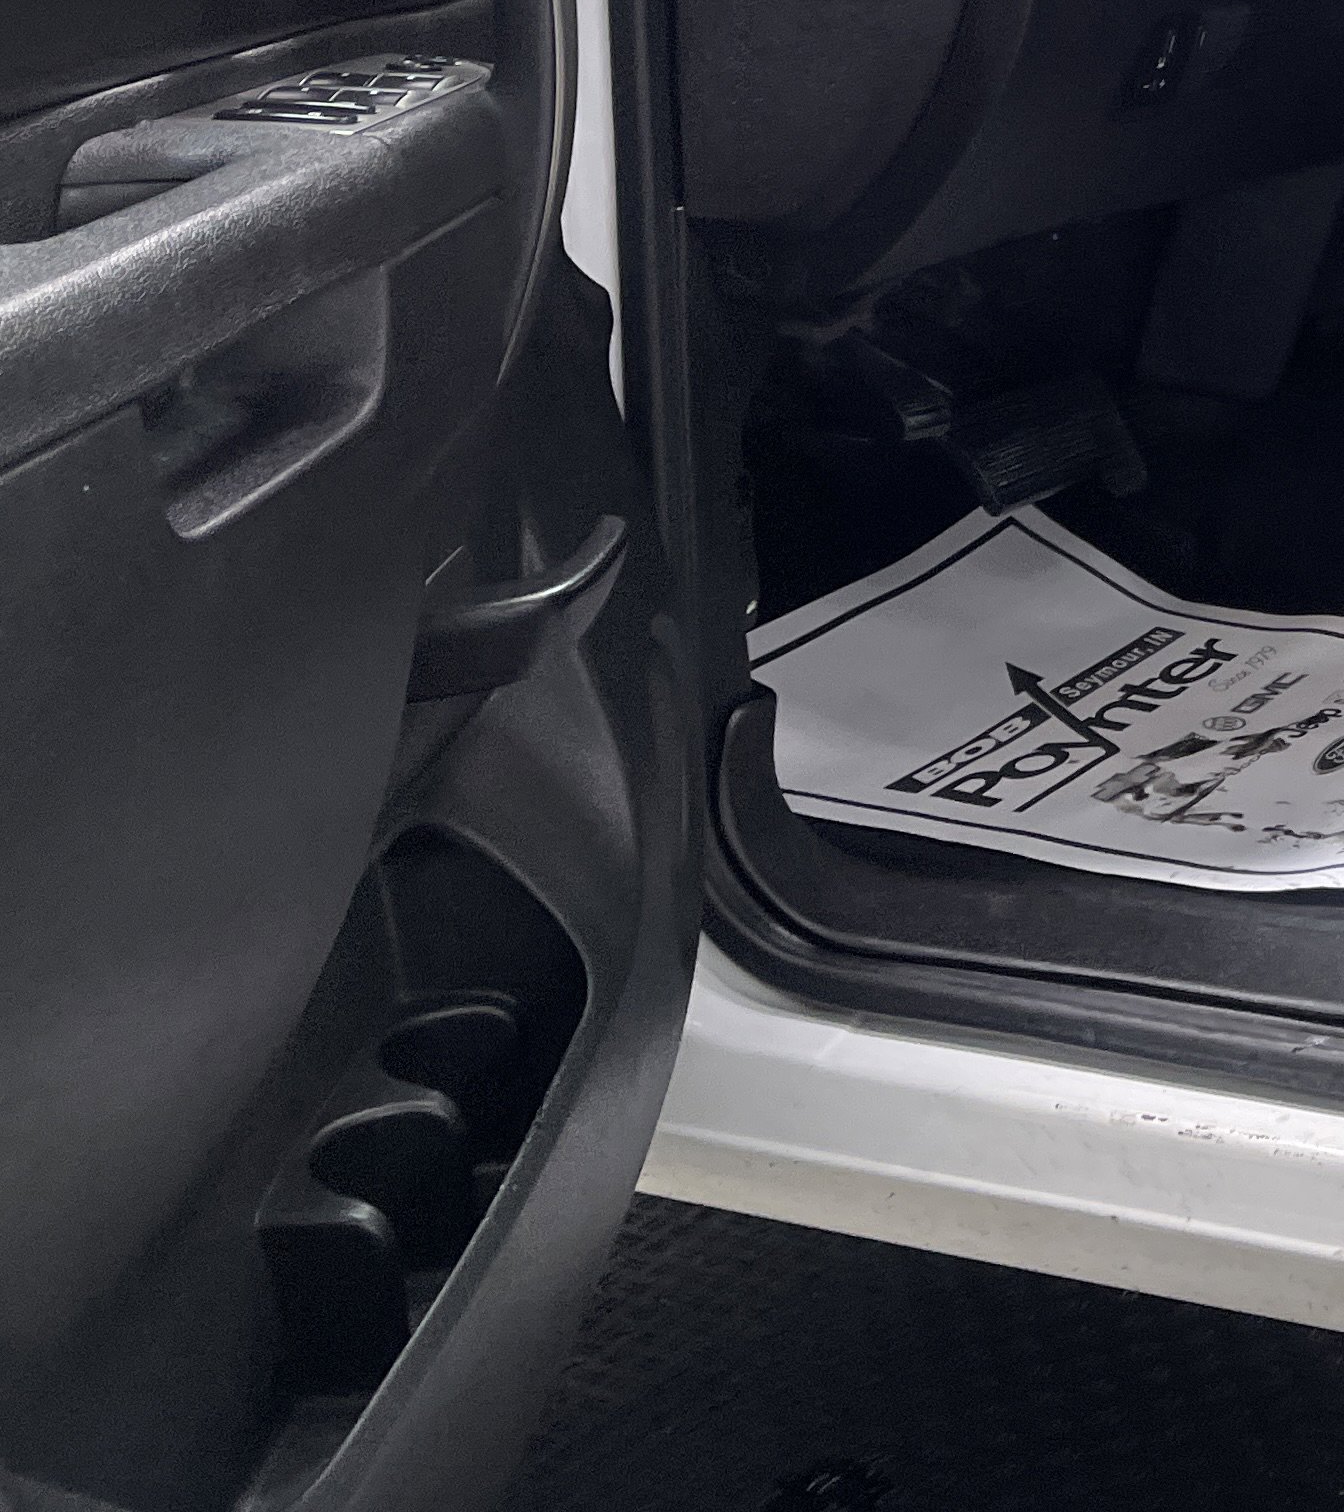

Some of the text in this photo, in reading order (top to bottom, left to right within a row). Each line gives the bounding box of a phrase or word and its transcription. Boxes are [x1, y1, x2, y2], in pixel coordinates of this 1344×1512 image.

[1058, 629, 1174, 699] Seymour, IN
[1230, 671, 1311, 714] GMC
[1245, 645, 1278, 670] 1979
[910, 715, 1032, 785] BOB
[928, 638, 1239, 812] Poynter
